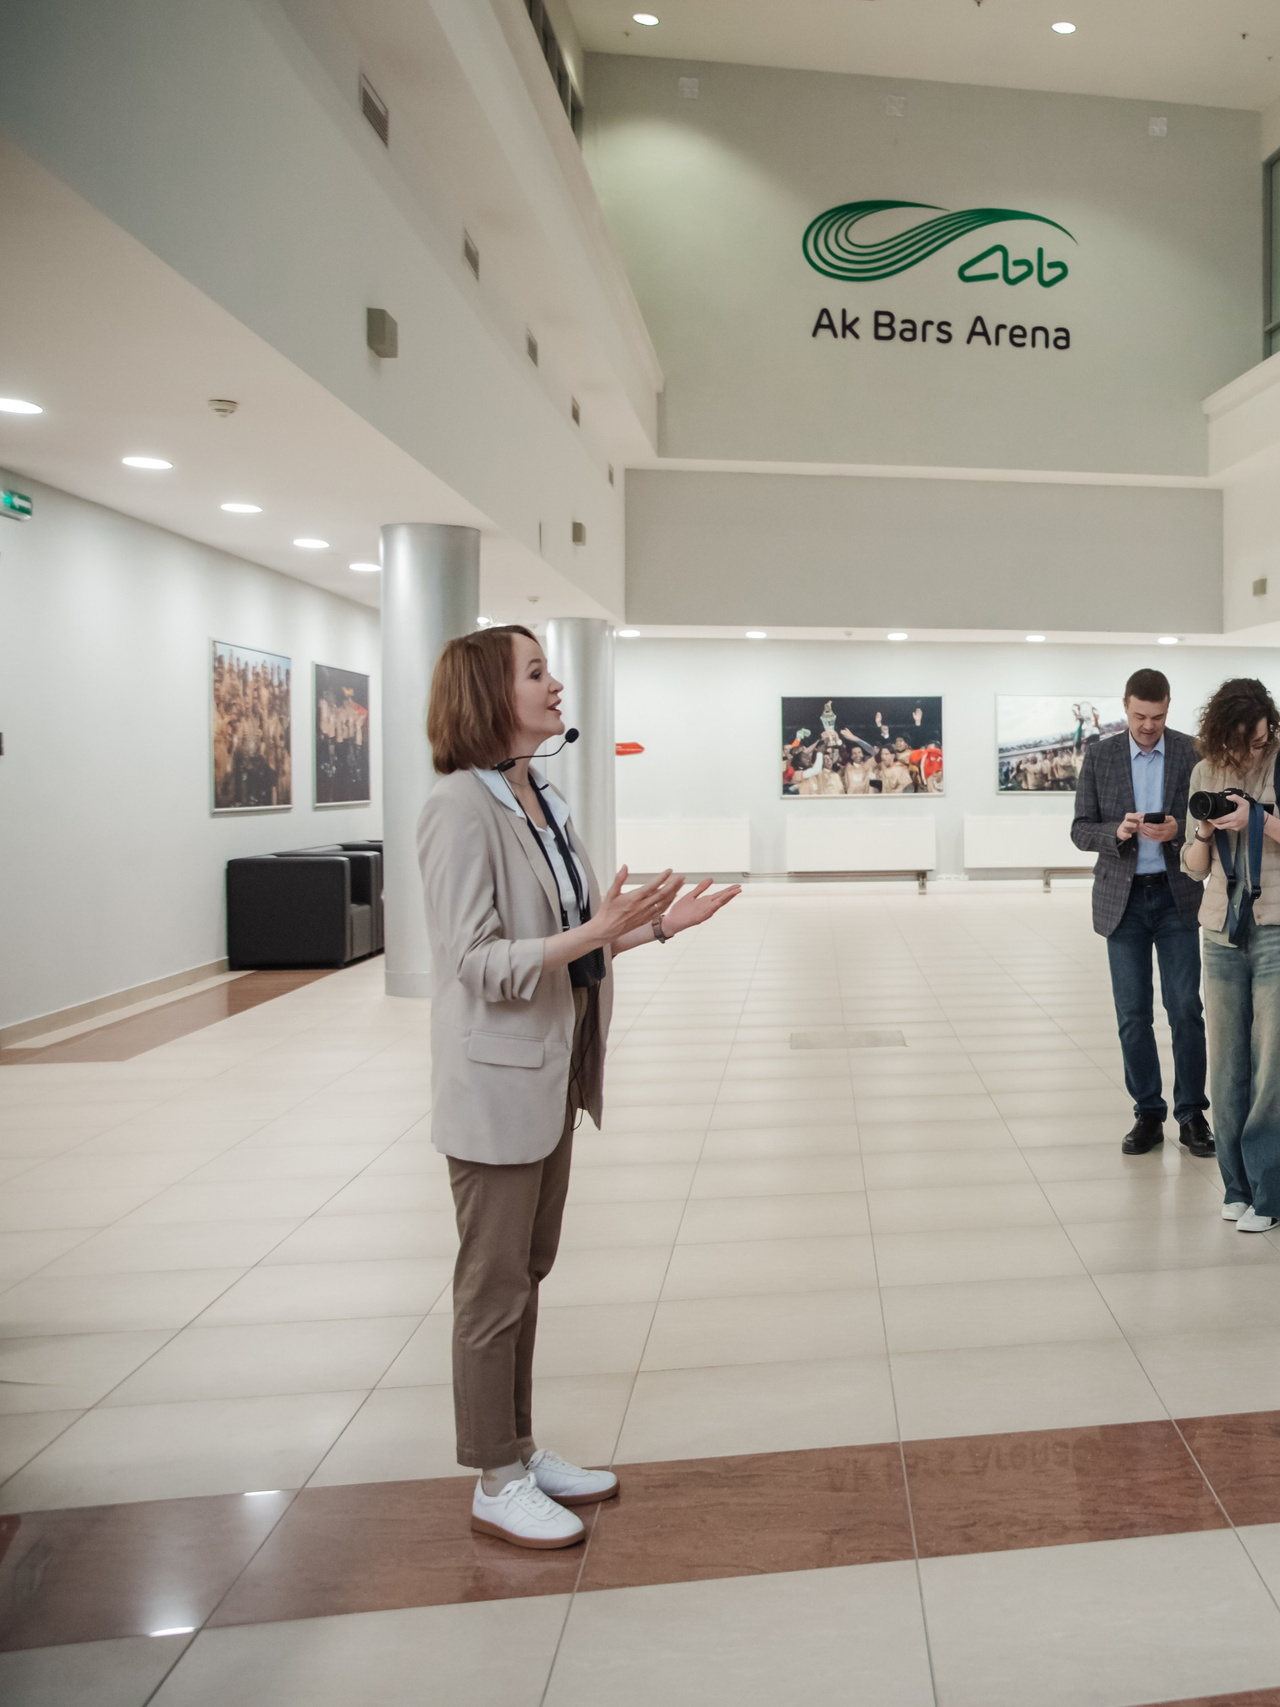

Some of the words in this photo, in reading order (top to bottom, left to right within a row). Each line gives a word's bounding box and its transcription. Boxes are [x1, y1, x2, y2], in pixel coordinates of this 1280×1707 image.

[812, 308, 860, 340] Ak
[874, 310, 953, 344] Bars
[966, 315, 1071, 350] Arena
